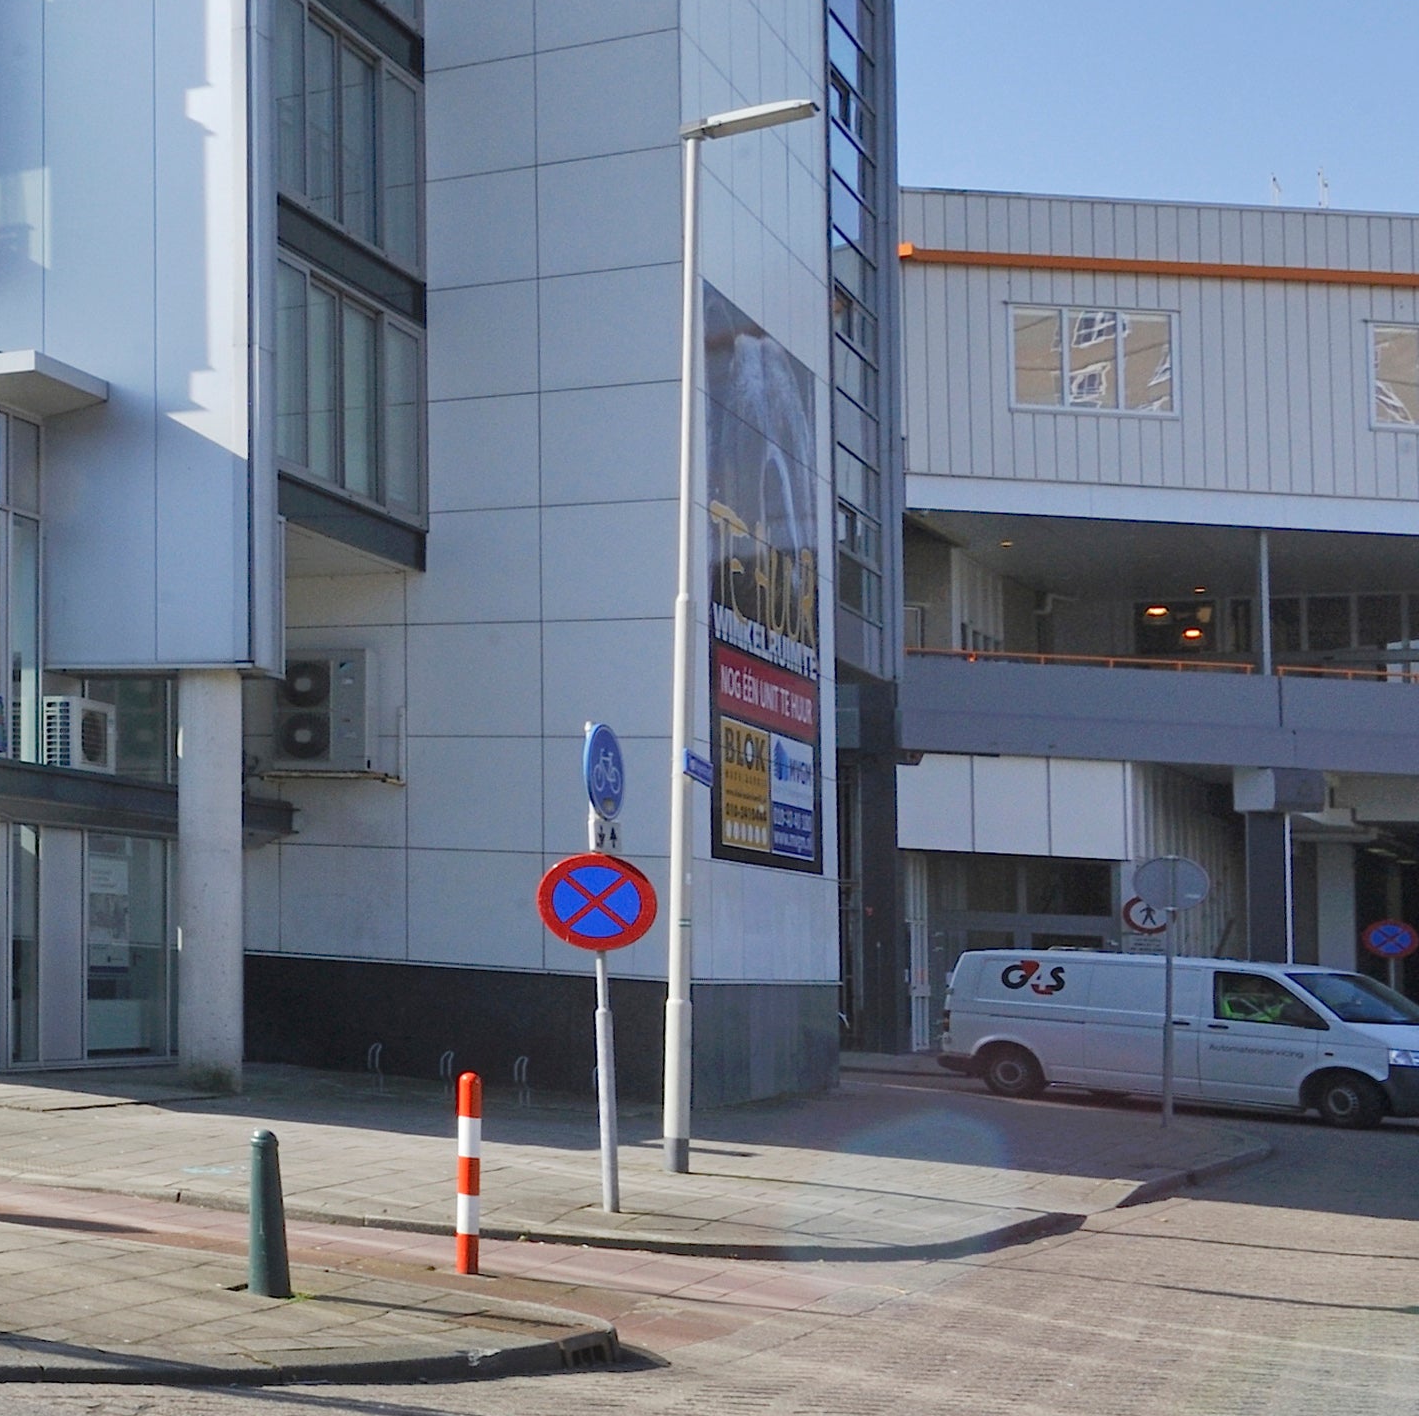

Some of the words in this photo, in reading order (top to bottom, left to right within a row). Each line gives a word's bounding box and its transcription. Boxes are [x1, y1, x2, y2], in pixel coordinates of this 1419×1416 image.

[755, 522, 817, 654] HUUR
[720, 664, 742, 700] NOG
[760, 682, 779, 712] UNIT
[780, 688, 792, 718] TE
[791, 693, 813, 726] HUUR
[724, 726, 766, 773] BLOK
[1001, 960, 1066, 995] G4S
